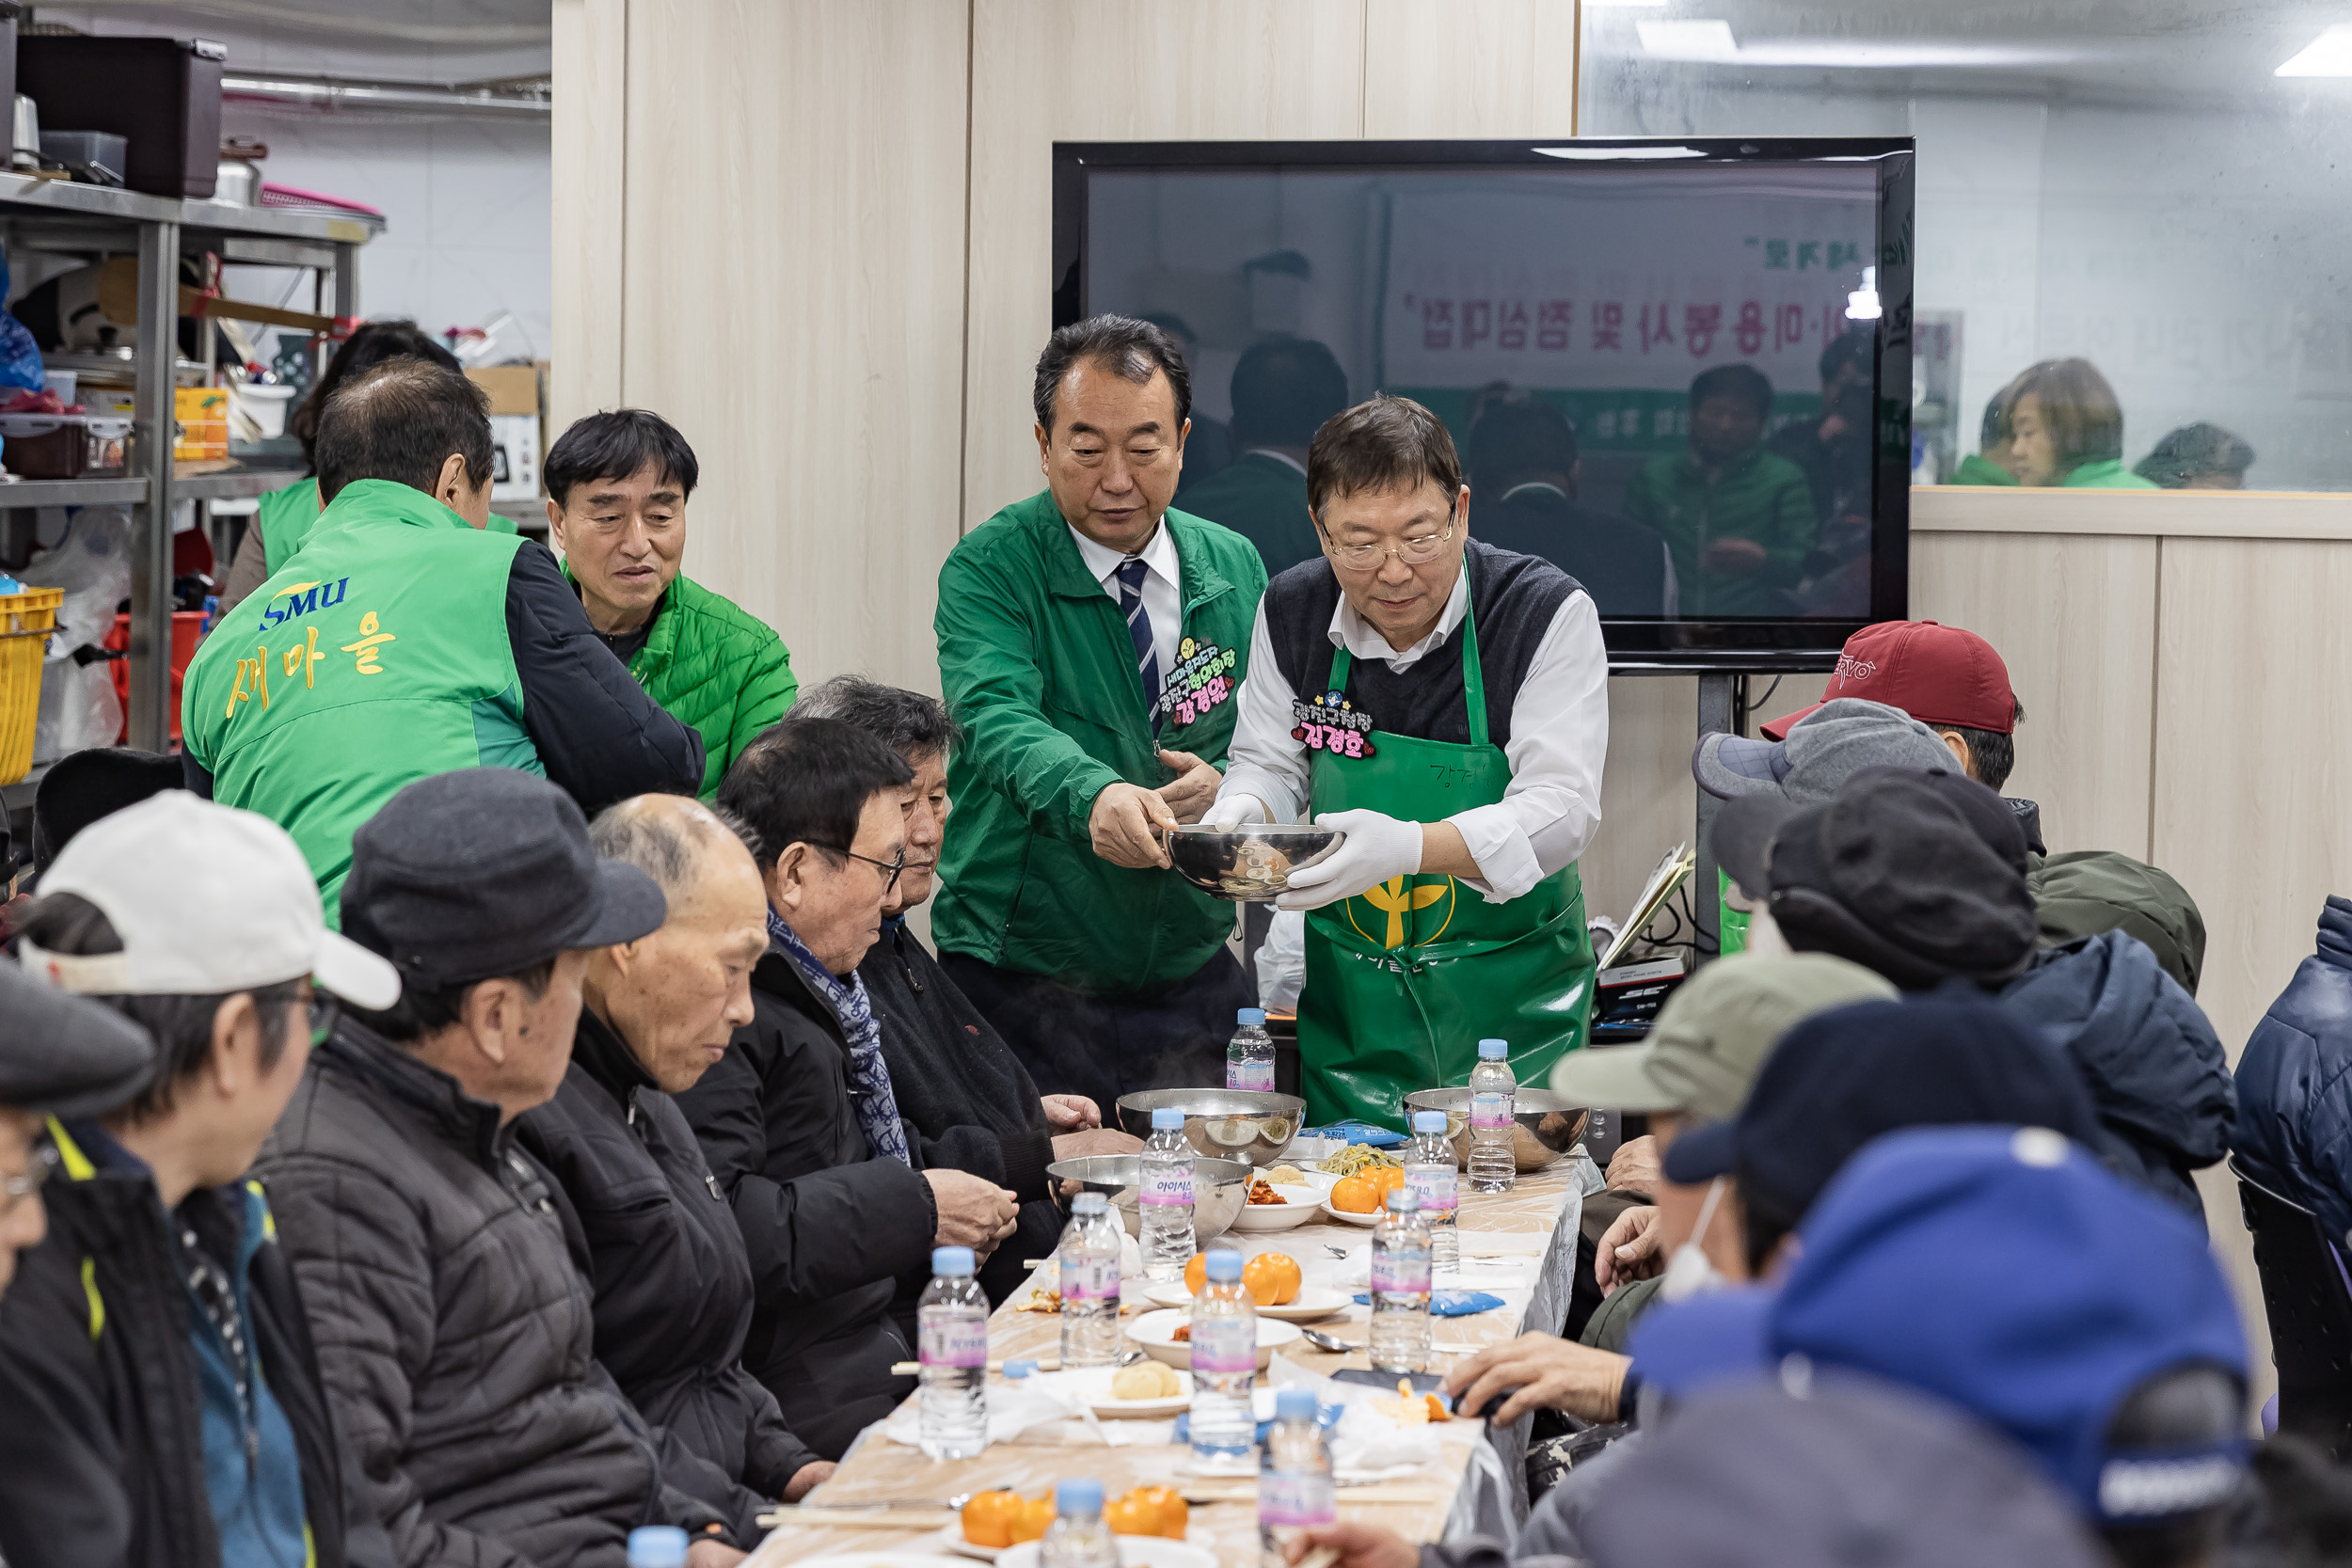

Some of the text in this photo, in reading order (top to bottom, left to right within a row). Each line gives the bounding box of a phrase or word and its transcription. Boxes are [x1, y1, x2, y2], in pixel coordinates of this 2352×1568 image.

[259, 578, 350, 631] SMU
[226, 611, 396, 719] 새마을
[1167, 645, 1219, 688] 새마을지도자
[1294, 701, 1373, 732] 광진구청장
[1301, 721, 1363, 758] 김경호
[1157, 1181, 1192, 1192] 아이시스
